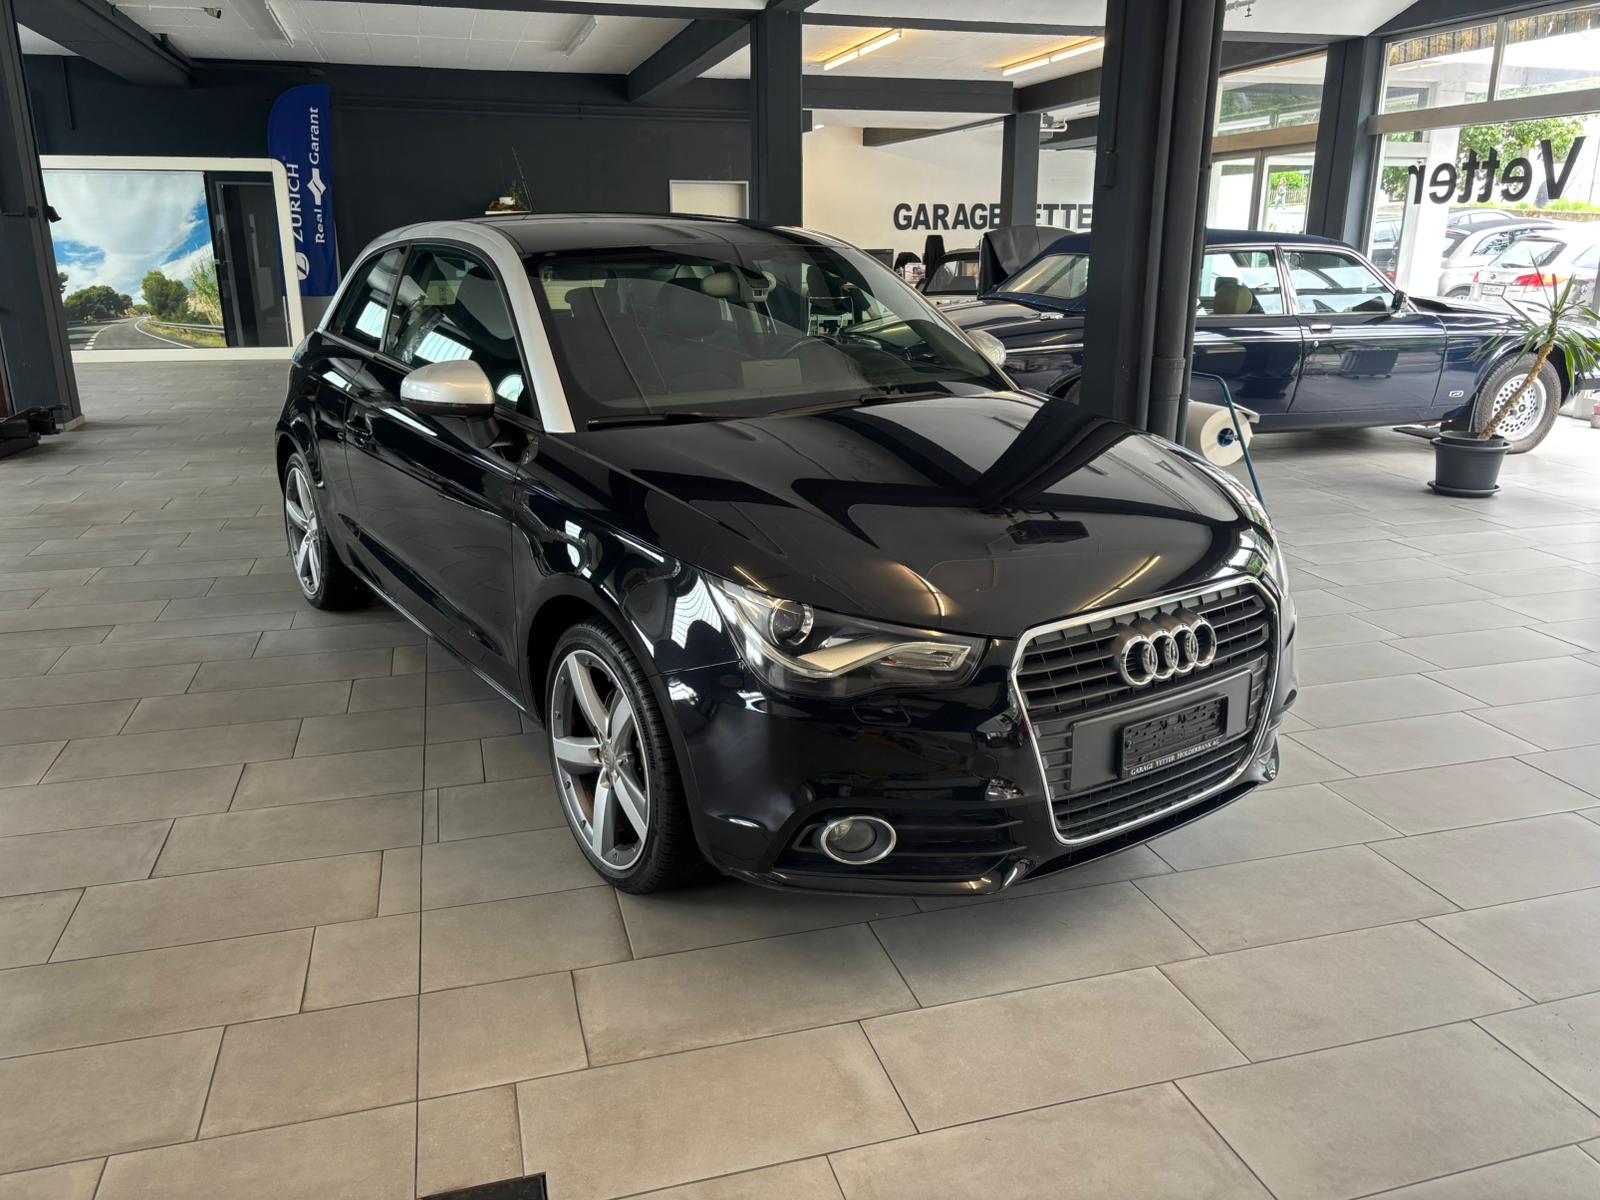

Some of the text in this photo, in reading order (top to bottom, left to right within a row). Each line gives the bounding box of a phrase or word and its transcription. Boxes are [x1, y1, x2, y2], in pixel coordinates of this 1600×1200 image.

[287, 163, 304, 243] ZURICH
[309, 106, 326, 244] Real Garant
[893, 203, 1001, 231] GARAGE
[1130, 763, 1154, 776] GARAGE
[1155, 754, 1176, 768] VETTER
[1176, 741, 1212, 760] HOLDERBANK
